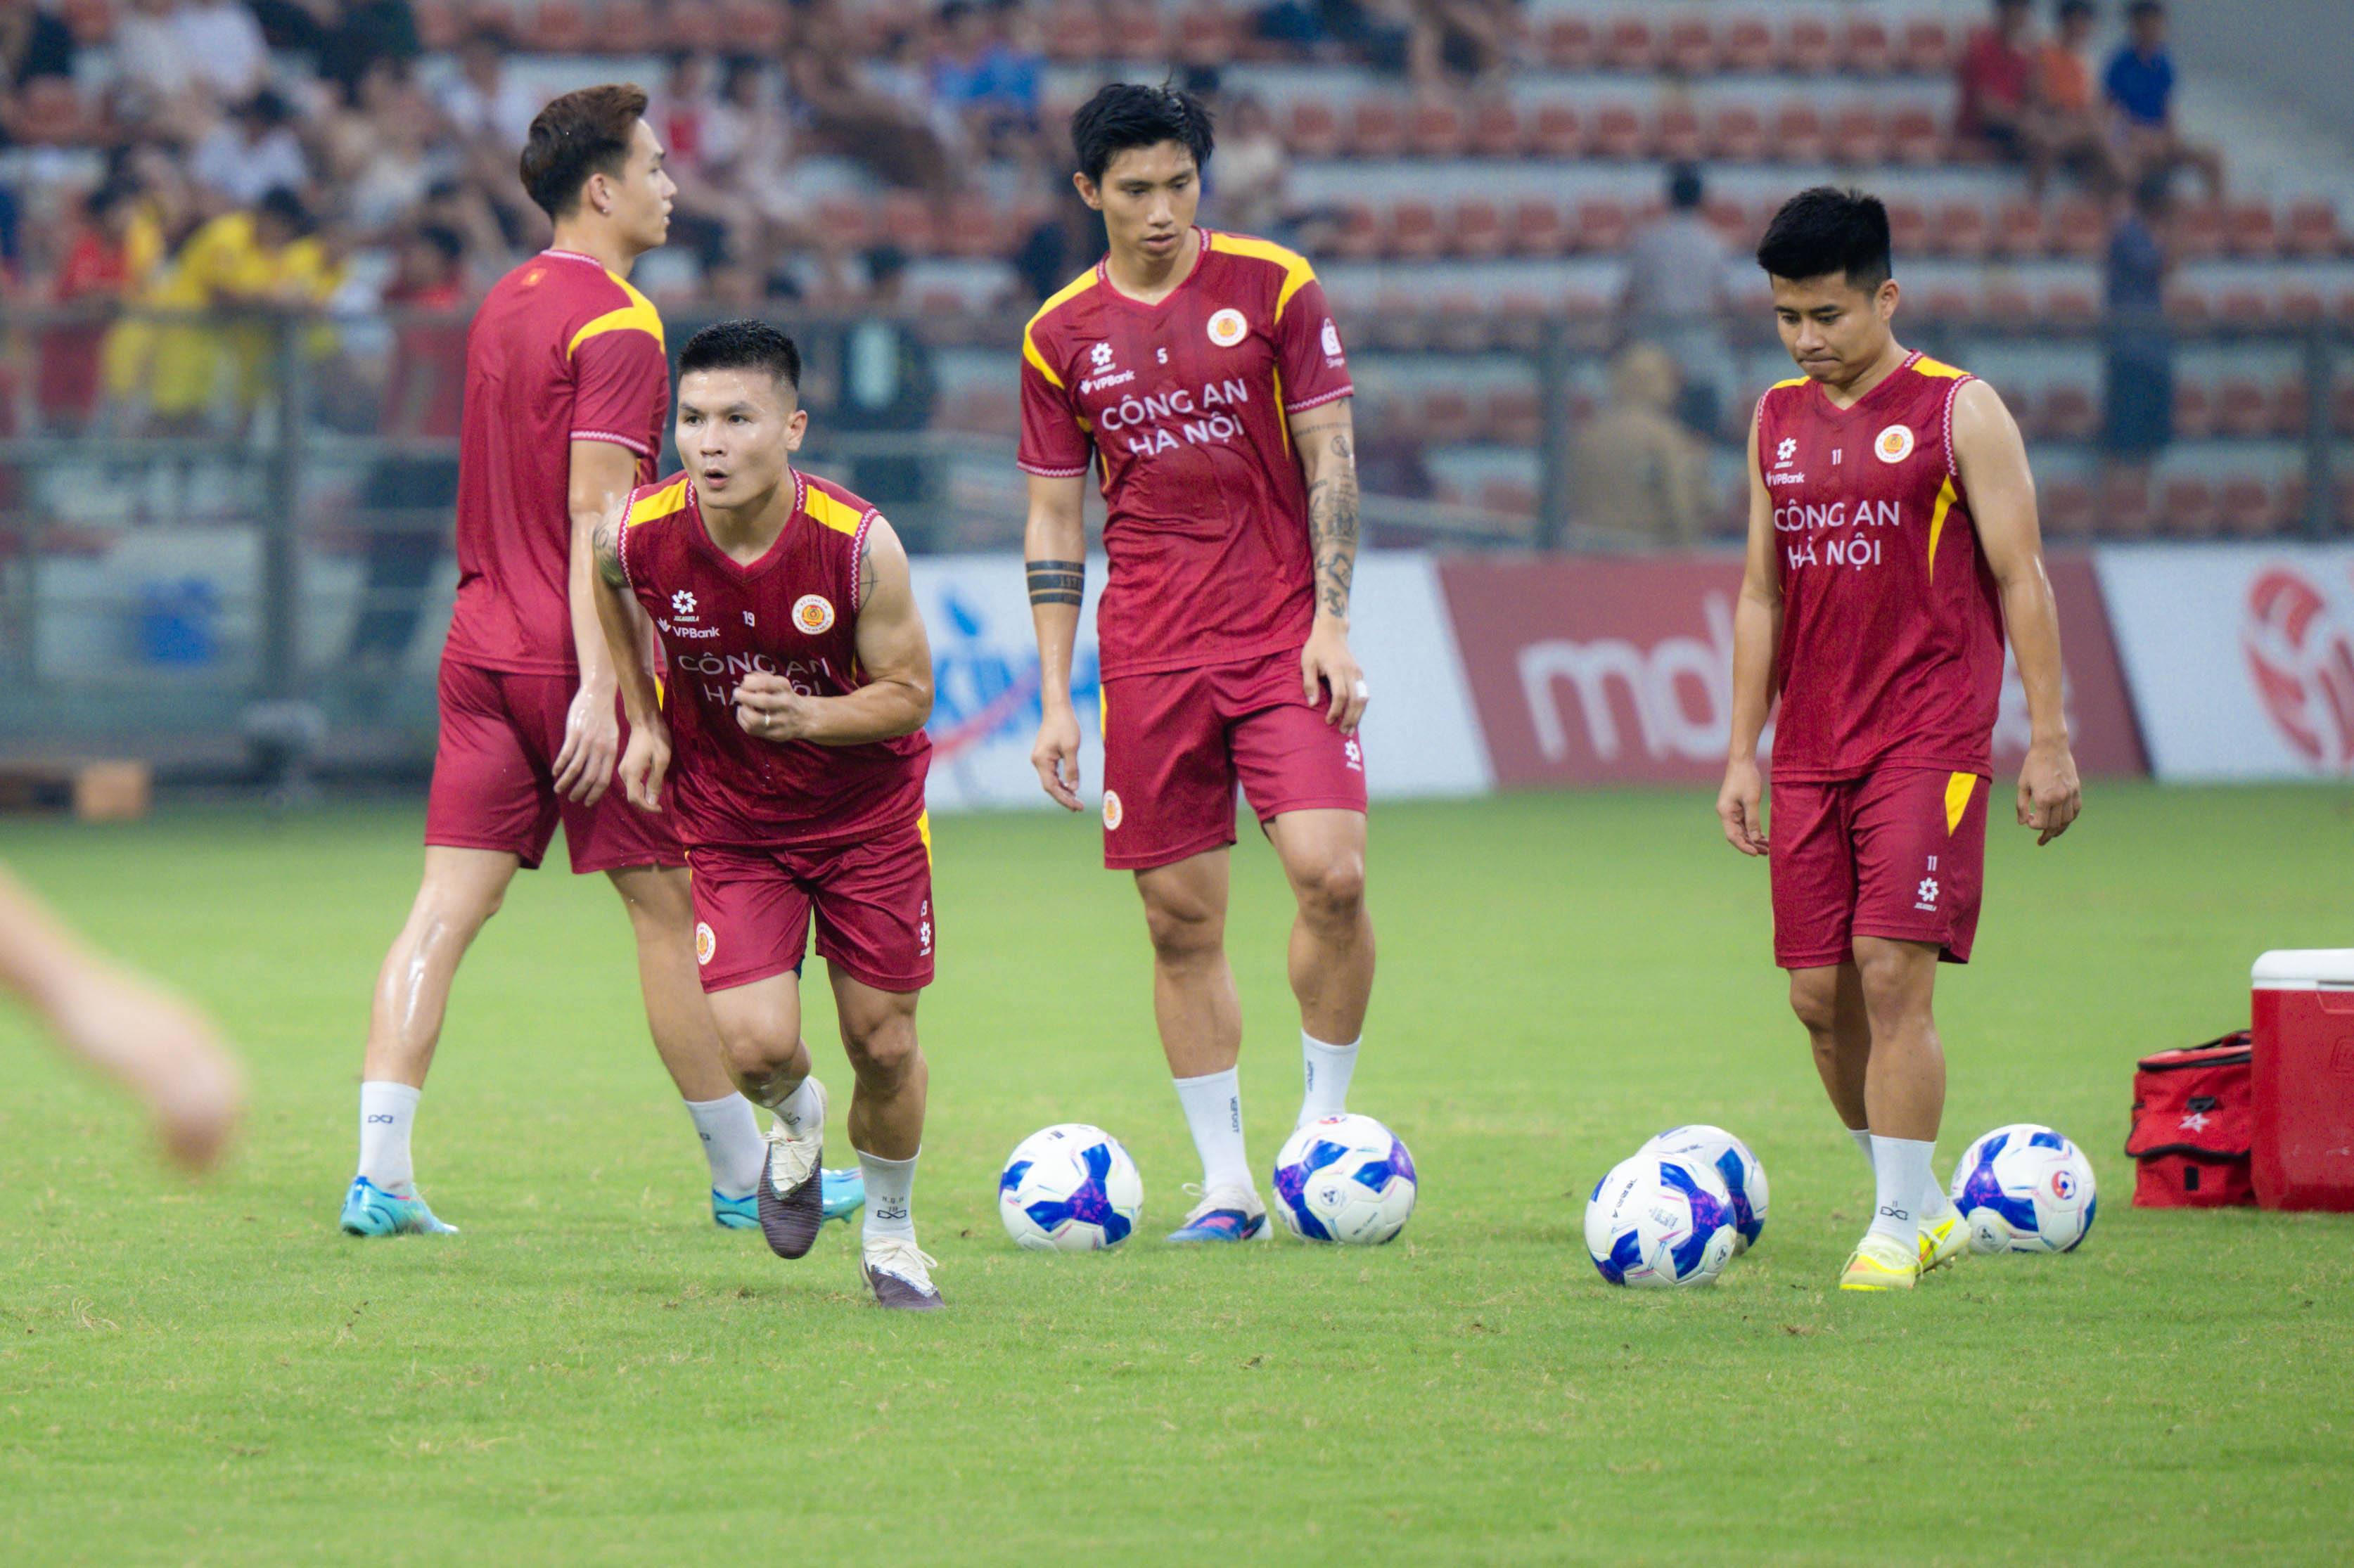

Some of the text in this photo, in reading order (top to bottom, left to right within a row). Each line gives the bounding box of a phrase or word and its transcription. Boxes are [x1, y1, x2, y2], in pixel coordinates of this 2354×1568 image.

[1156, 347, 1168, 364] 5
[1092, 370, 1136, 391] VPBank
[1101, 378, 1248, 431] CÔNG AN
[1183, 411, 1244, 444] NỘI
[1831, 448, 1842, 465] 11
[1772, 472, 1805, 486] VPBank
[1774, 499, 1900, 532] CÔNG AN
[1826, 532, 1881, 571] NỘI
[743, 610, 755, 627] 19
[672, 626, 721, 638] VPBank
[678, 652, 831, 678] CÔNG AN
[1927, 854, 1938, 871] 11
